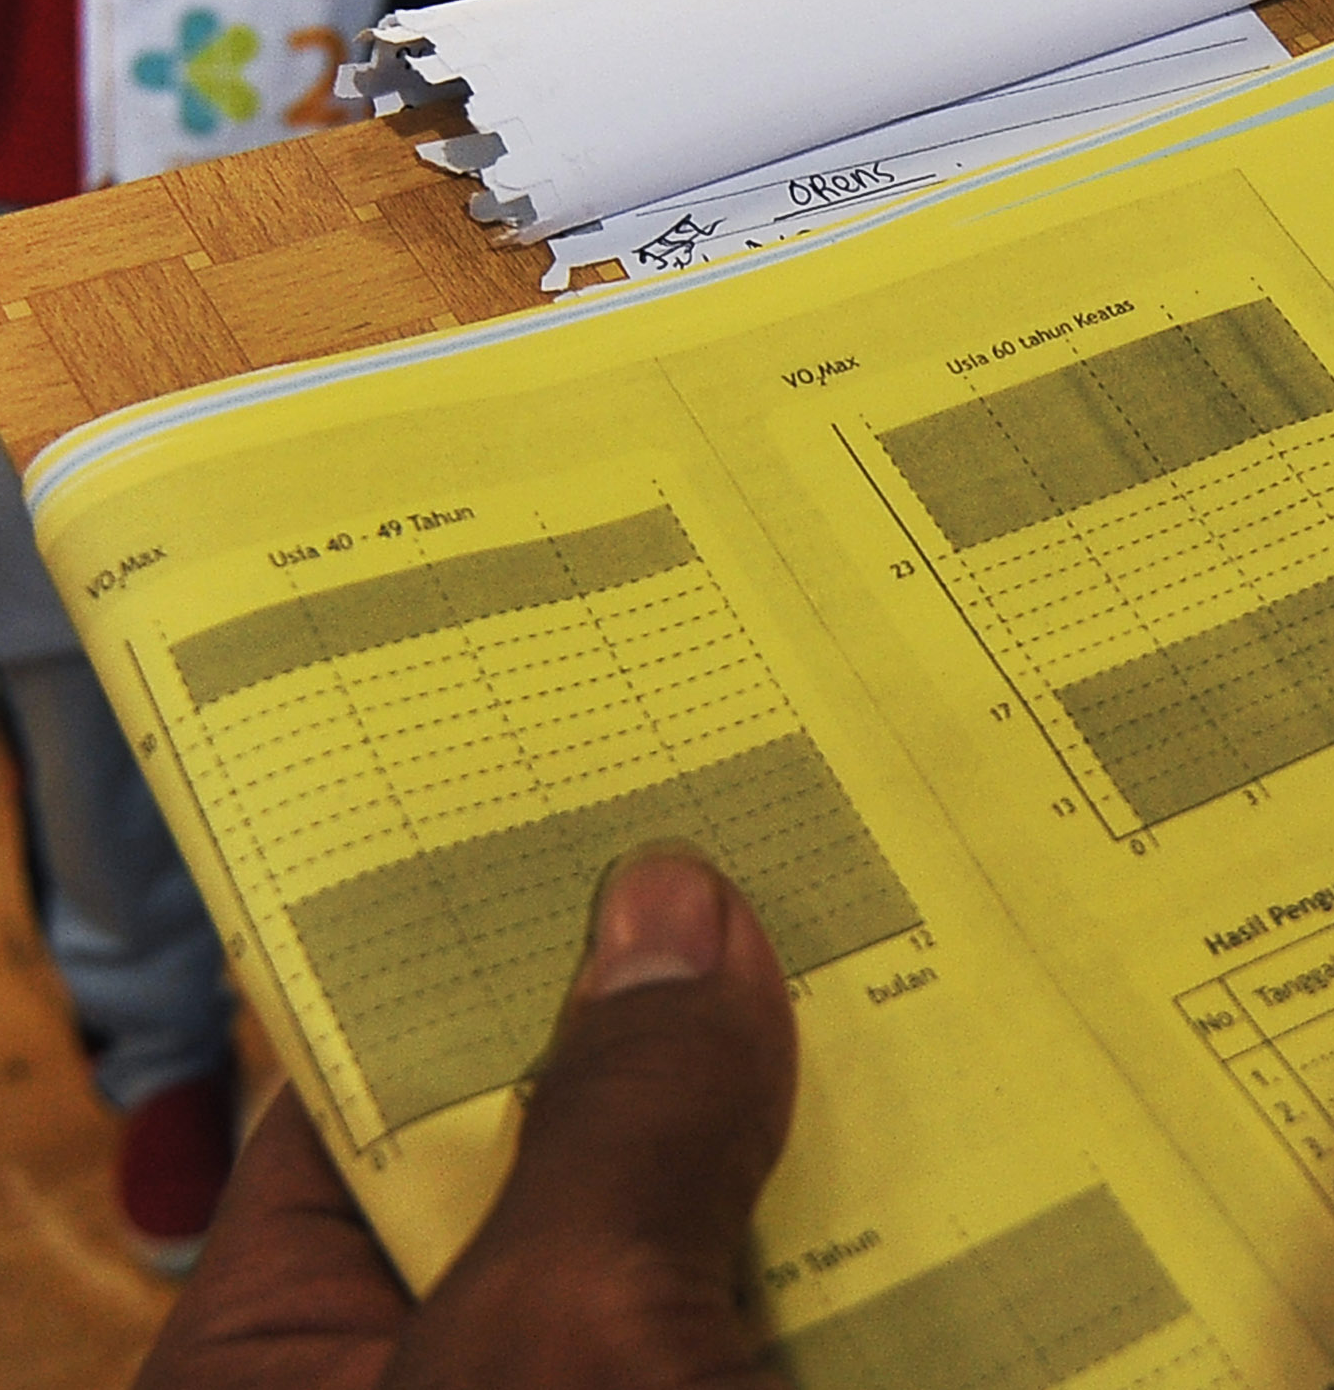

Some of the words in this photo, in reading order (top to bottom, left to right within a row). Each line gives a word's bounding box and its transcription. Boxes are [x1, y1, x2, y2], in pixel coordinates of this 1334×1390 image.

[946, 347, 989, 377] Usia
[991, 339, 1016, 361] 60
[1018, 319, 1074, 352] tahun
[1073, 297, 1135, 334] Keatas
[267, 544, 321, 569] Usia
[325, 531, 354, 554] 40
[376, 518, 404, 540] 49
[406, 504, 476, 534] Tahun
[889, 558, 916, 580] 23
[989, 703, 1013, 724] 17
[1051, 795, 1078, 818] 13
[908, 928, 937, 952] 12
[1204, 913, 1270, 956] Hasil
[866, 966, 939, 1005] bulan
[1195, 1010, 1235, 1036] No
